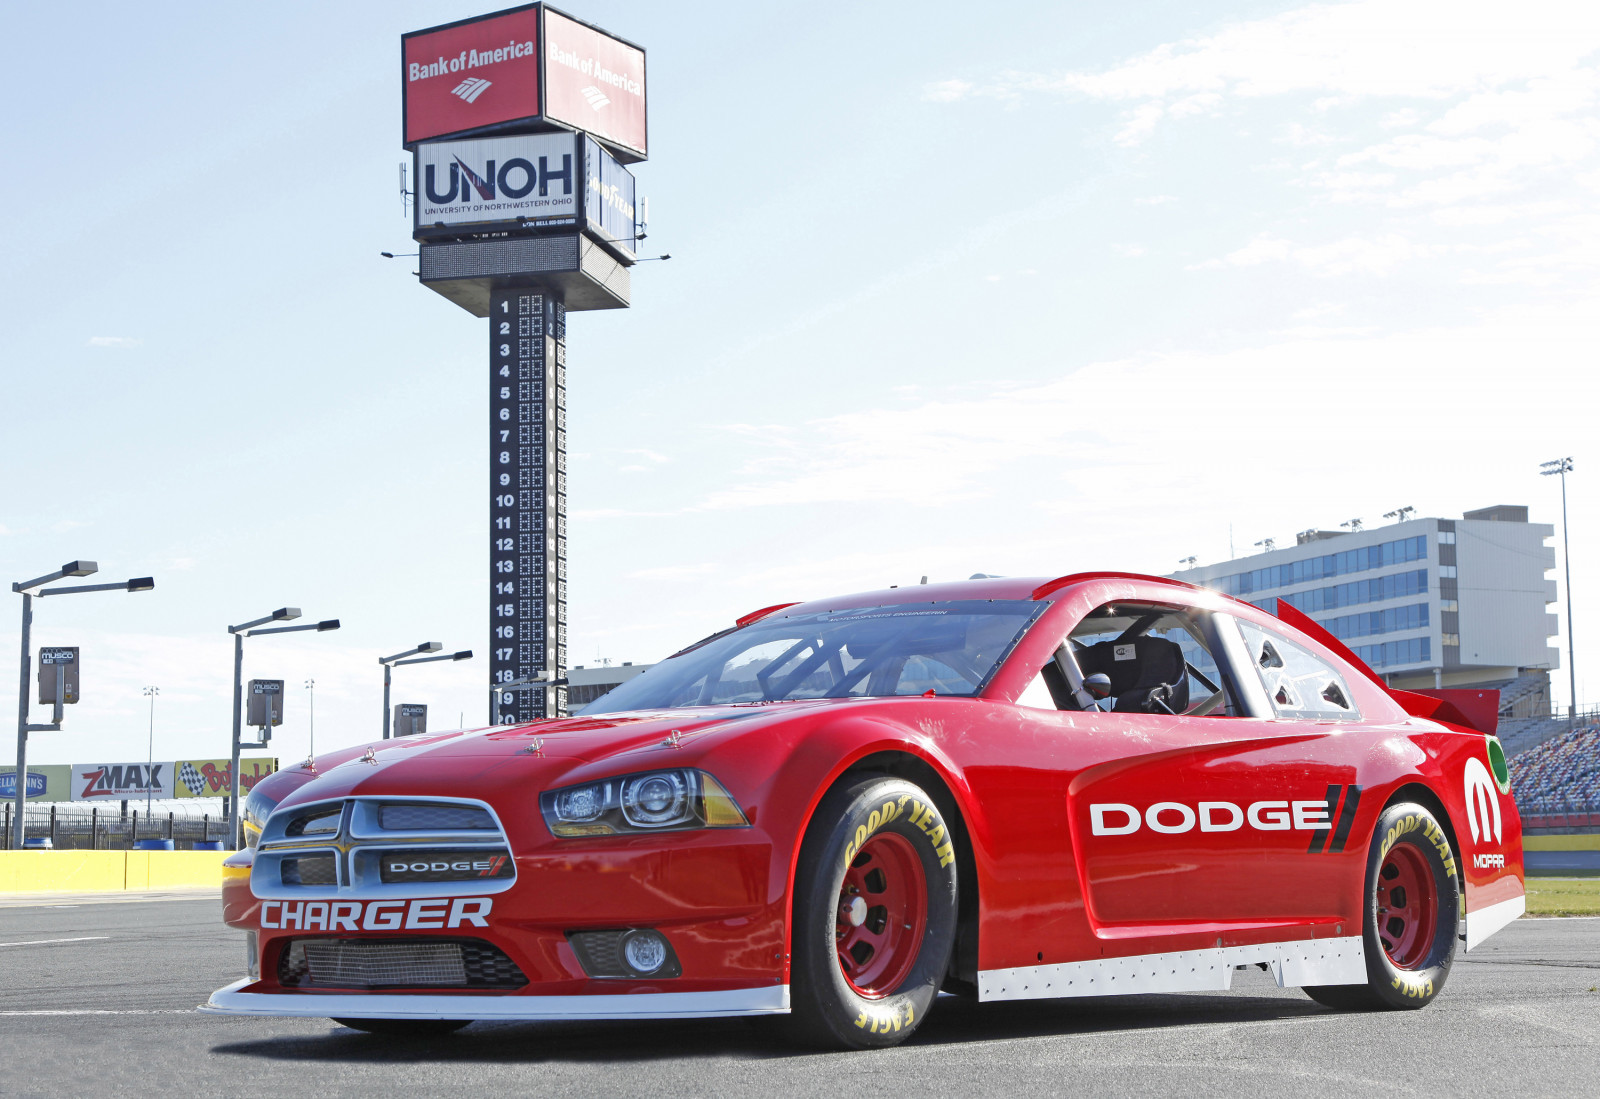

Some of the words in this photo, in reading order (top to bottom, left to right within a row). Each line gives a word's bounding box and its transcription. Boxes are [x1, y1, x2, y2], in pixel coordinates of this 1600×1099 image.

[409, 57, 448, 82] Bank
[450, 51, 466, 72] of
[468, 40, 534, 69] America
[549, 41, 580, 71] Bank
[581, 58, 593, 76] of
[594, 61, 641, 96] America
[425, 152, 572, 204] UNOH
[424, 205, 472, 215] UNIVERSITY
[473, 204, 484, 212] OF
[484, 199, 550, 212] NORTHWESTERN
[552, 197, 573, 206] OHIO
[500, 301, 509, 313] 1
[500, 322, 510, 335] 2
[500, 343, 510, 356] 3
[499, 365, 510, 378] 4
[500, 386, 510, 399] 5
[500, 408, 510, 421] 6
[500, 429, 510, 442] 7
[499, 451, 510, 464] 8
[499, 472, 510, 486] 9
[496, 494, 514, 507] 10
[496, 516, 511, 530] 11
[496, 538, 514, 551] 12
[496, 560, 514, 573] 13
[496, 581, 514, 595] 14
[496, 603, 514, 617] 15
[496, 625, 514, 639] 16
[496, 648, 514, 661] 17
[496, 669, 514, 683] 18
[1090, 801, 1333, 836] DODGE
[844, 795, 955, 869] GOODYEAR
[1380, 814, 1458, 878] GOODYEAR
[390, 860, 492, 873] DODGE
[1473, 853, 1505, 869] MOPAR
[260, 898, 494, 931] CHARGER
[1391, 976, 1434, 999] EAGLE
[854, 1002, 915, 1035] EAGLE
